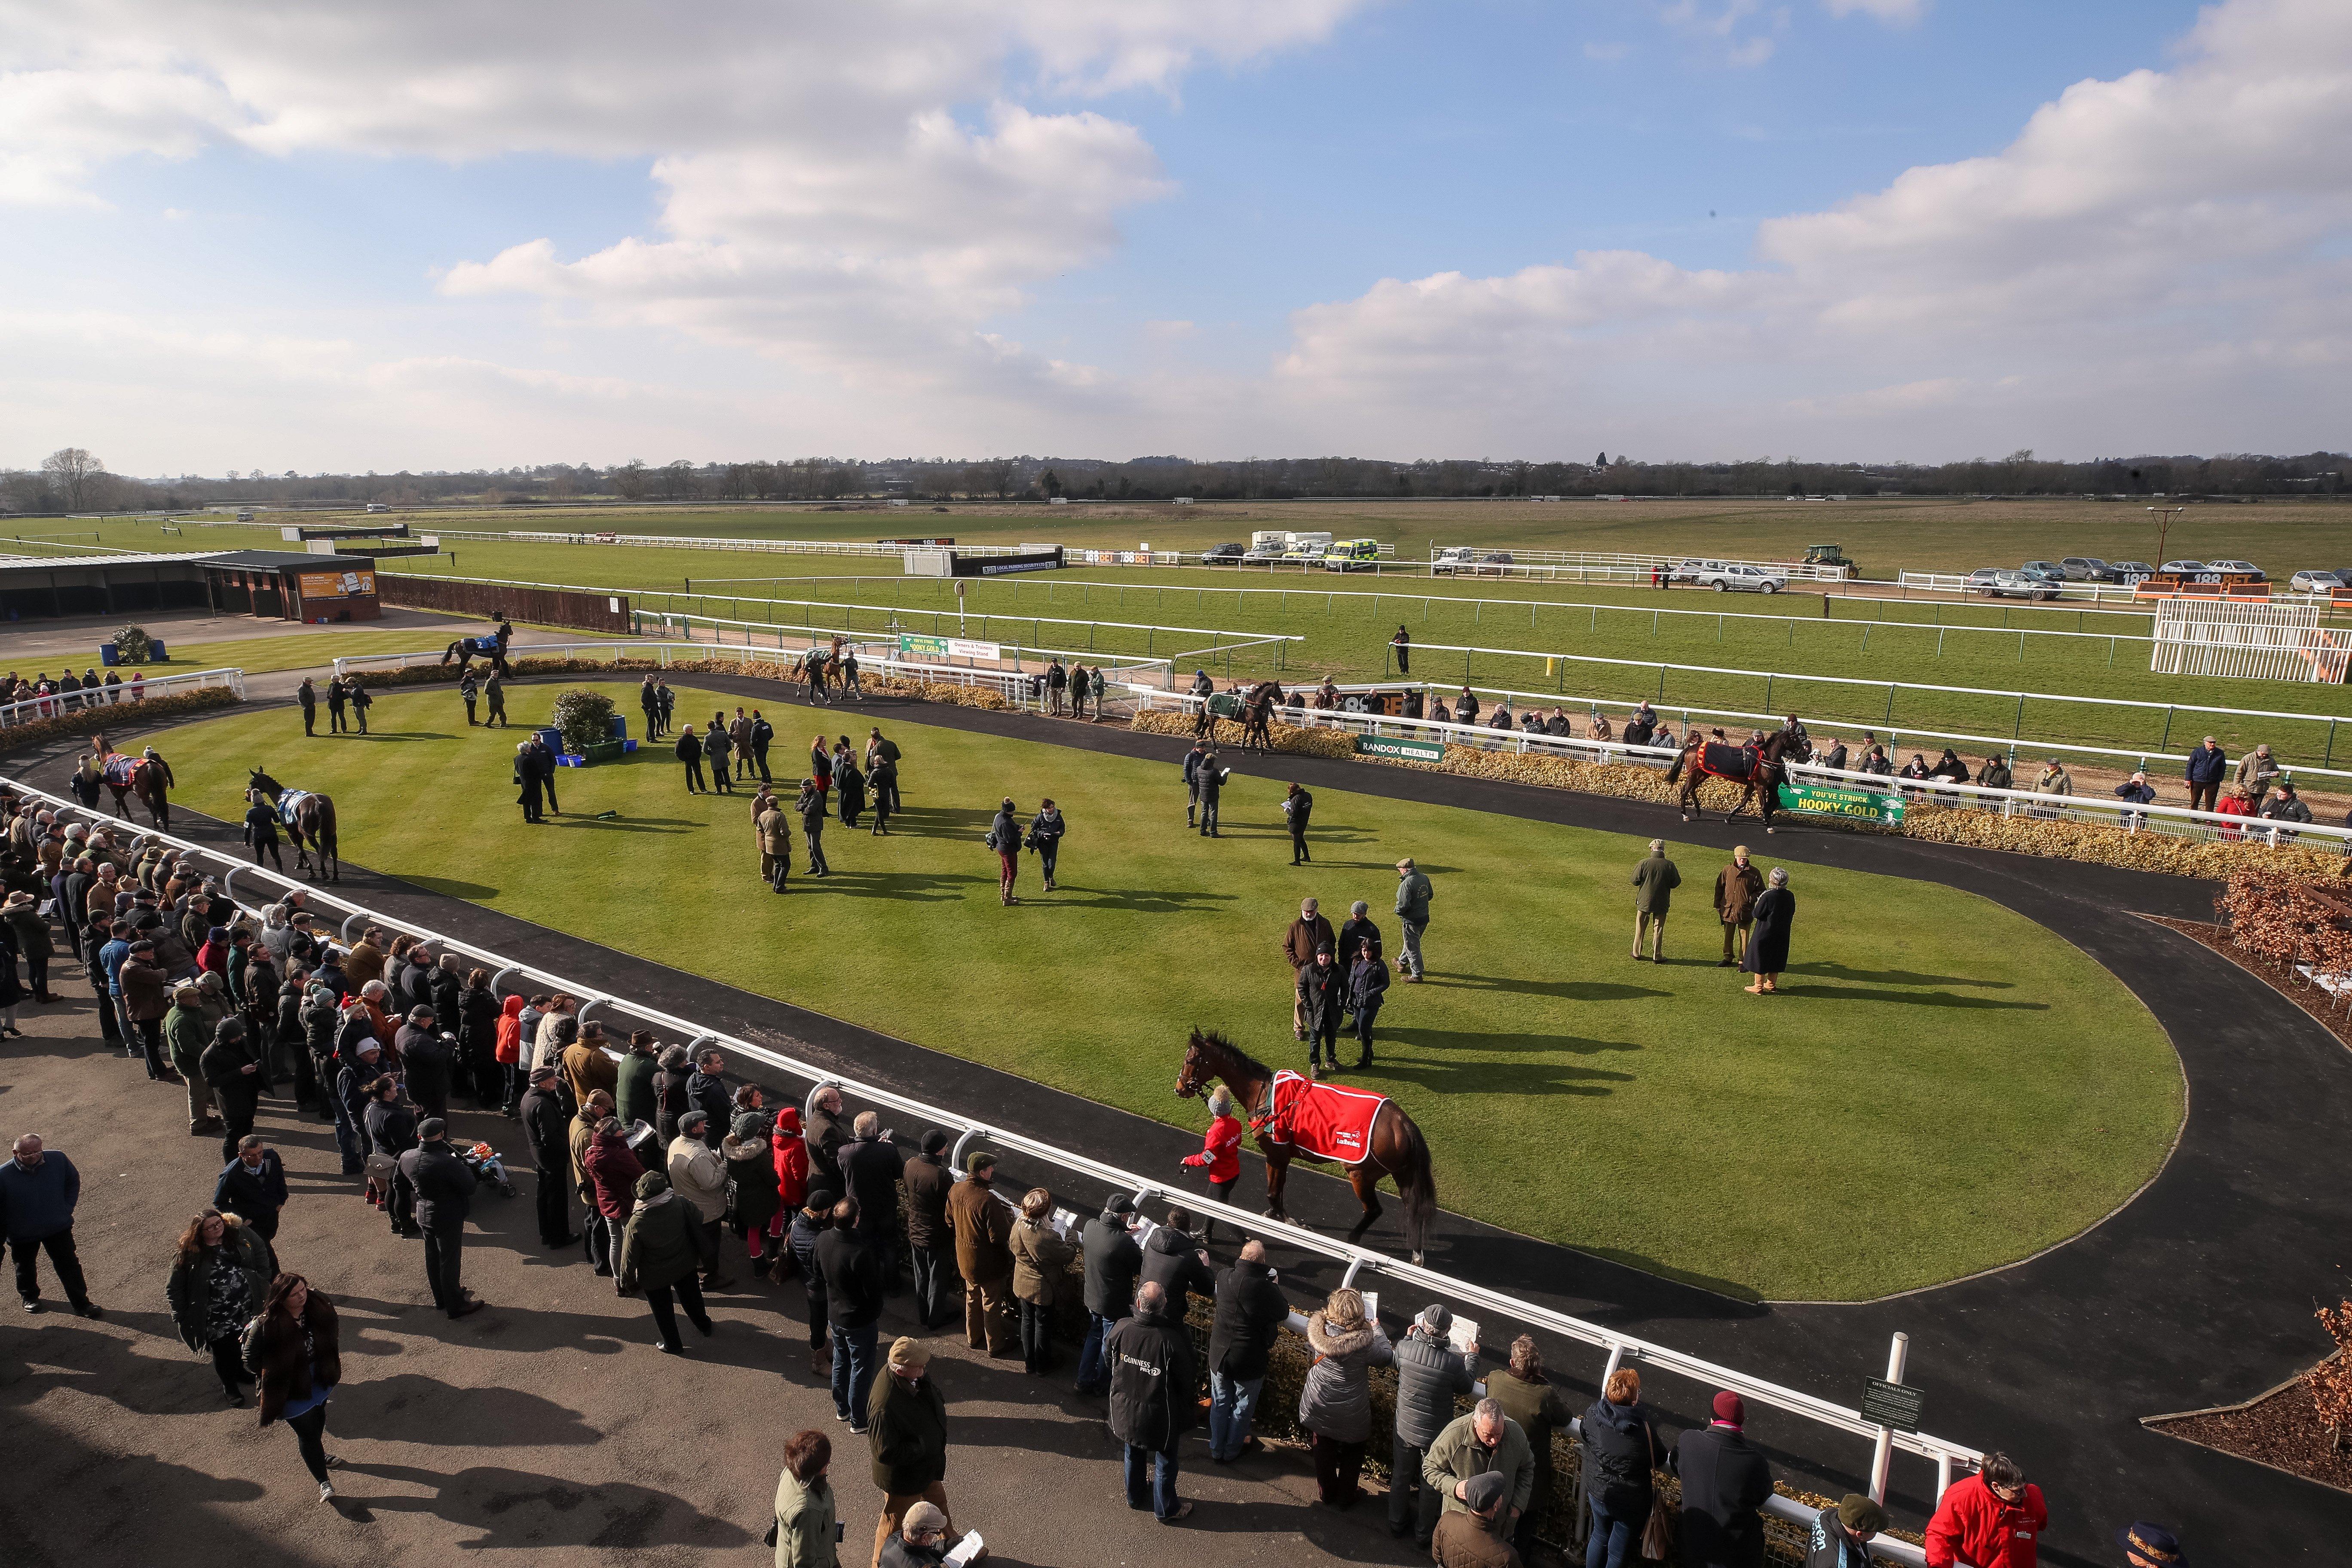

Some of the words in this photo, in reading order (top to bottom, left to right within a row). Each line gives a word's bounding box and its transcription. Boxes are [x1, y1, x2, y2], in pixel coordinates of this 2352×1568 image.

[959, 582, 964, 595] 1
[1363, 742, 1400, 754] RANDOX
[1406, 749, 1434, 758] HEALTH
[1811, 790, 1837, 799] YOU'VE
[1839, 794, 1868, 803] STRUCK
[1798, 798, 1842, 812] HOOKY
[1844, 805, 1878, 818] GOLD
[1124, 1355, 1151, 1368] GUINNESS
[1872, 1381, 1900, 1392] OFFICIALS
